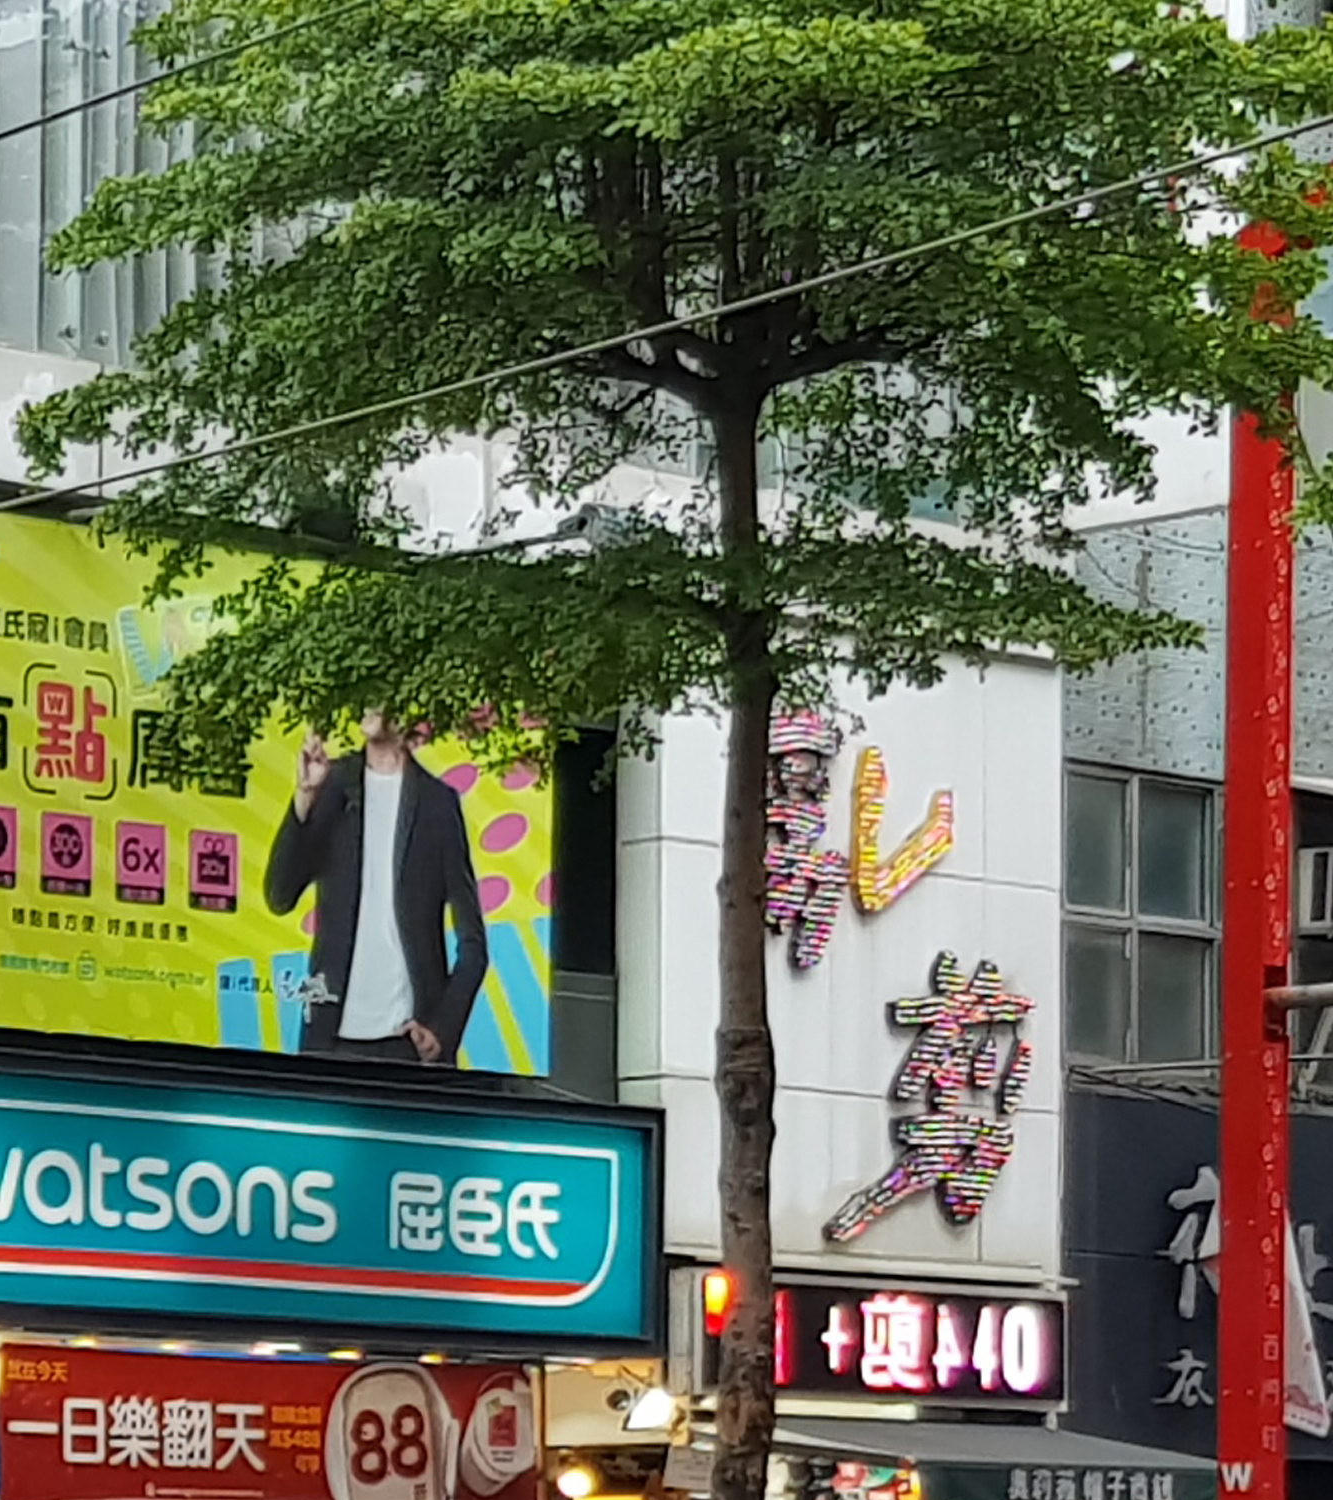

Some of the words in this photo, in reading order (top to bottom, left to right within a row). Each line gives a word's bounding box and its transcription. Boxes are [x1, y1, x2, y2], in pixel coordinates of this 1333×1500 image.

[122, 838, 160, 874] 6x
[389, 1171, 562, 1259] 屈臣氏
[7, 1395, 265, 1472] 一日樂翻天
[351, 1404, 428, 1485] 88
[1221, 1462, 1253, 1491] W
